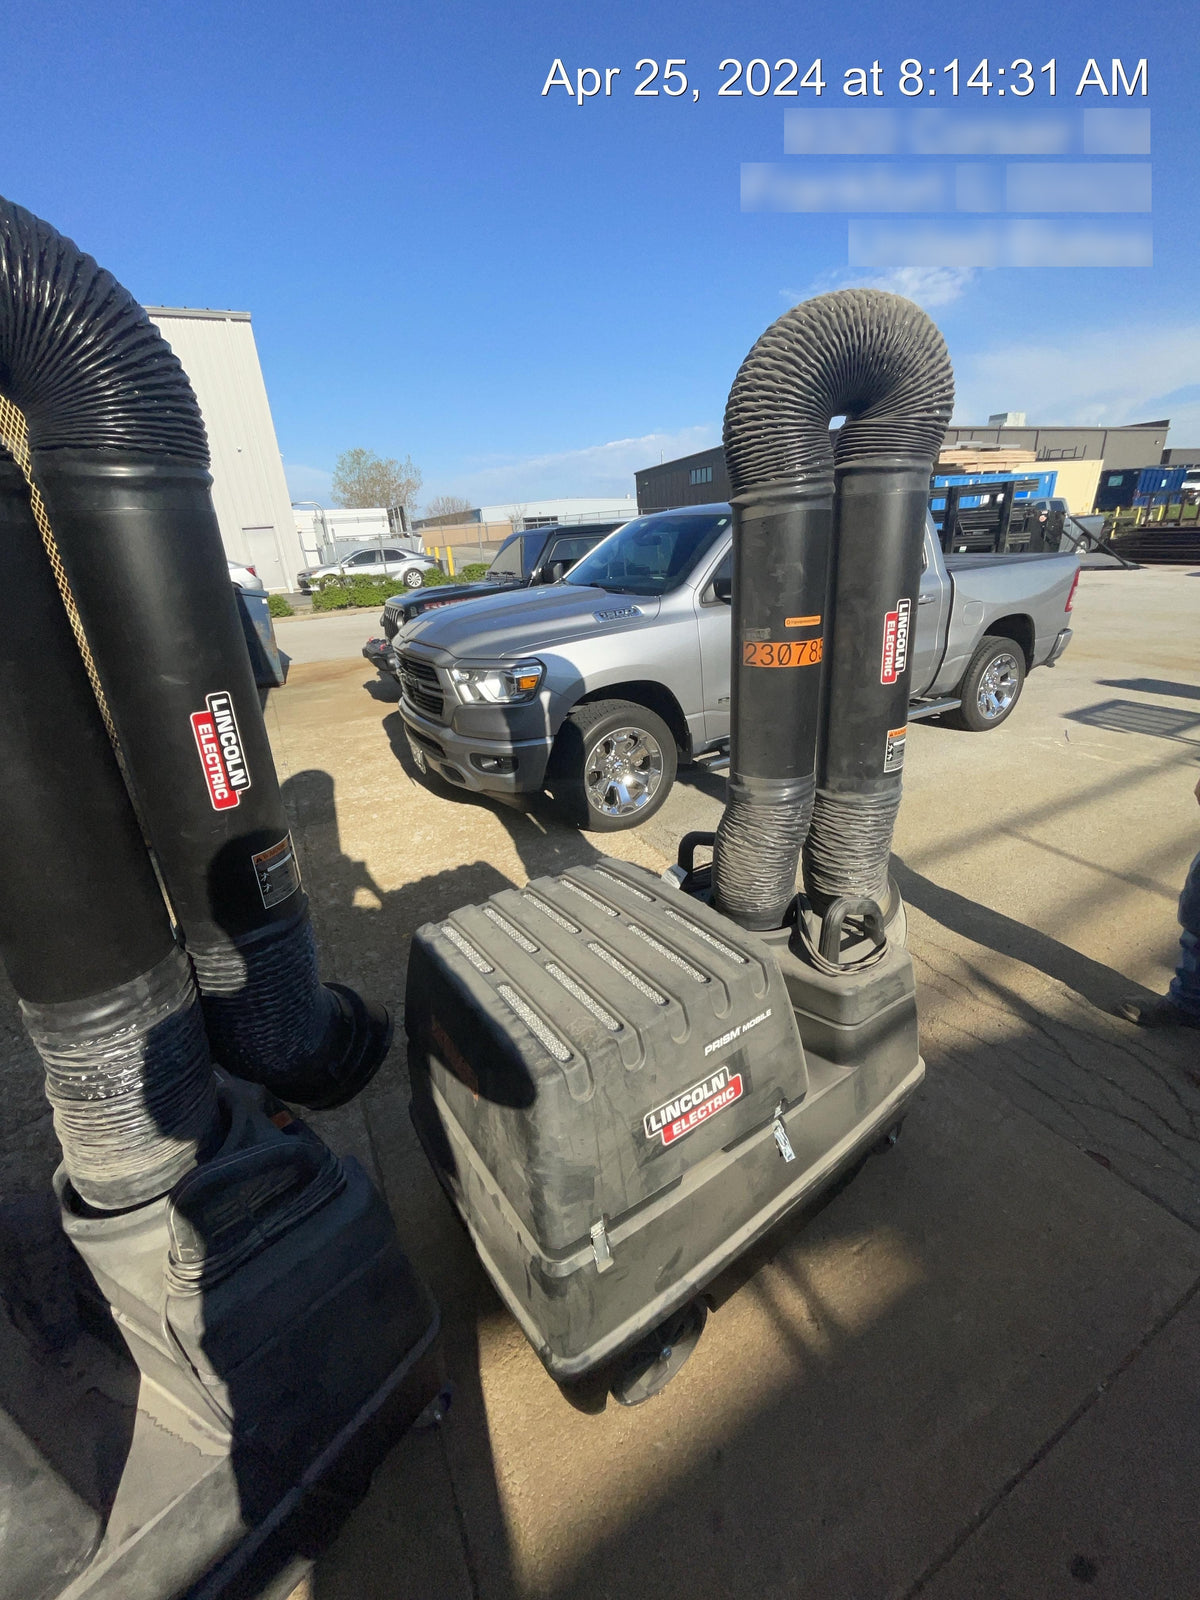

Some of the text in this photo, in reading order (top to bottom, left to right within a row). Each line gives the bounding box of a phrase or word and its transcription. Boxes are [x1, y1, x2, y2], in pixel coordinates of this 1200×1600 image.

[884, 620, 896, 677] ELECTRIC
[893, 602, 909, 672] LINCOLN
[198, 722, 229, 800] ELECTRIC
[211, 698, 248, 788] LINCOLN
[704, 1008, 772, 1056] PRISM MOBILE
[649, 1073, 725, 1132] LINCOLN
[671, 1086, 735, 1136] ELECTRIC
